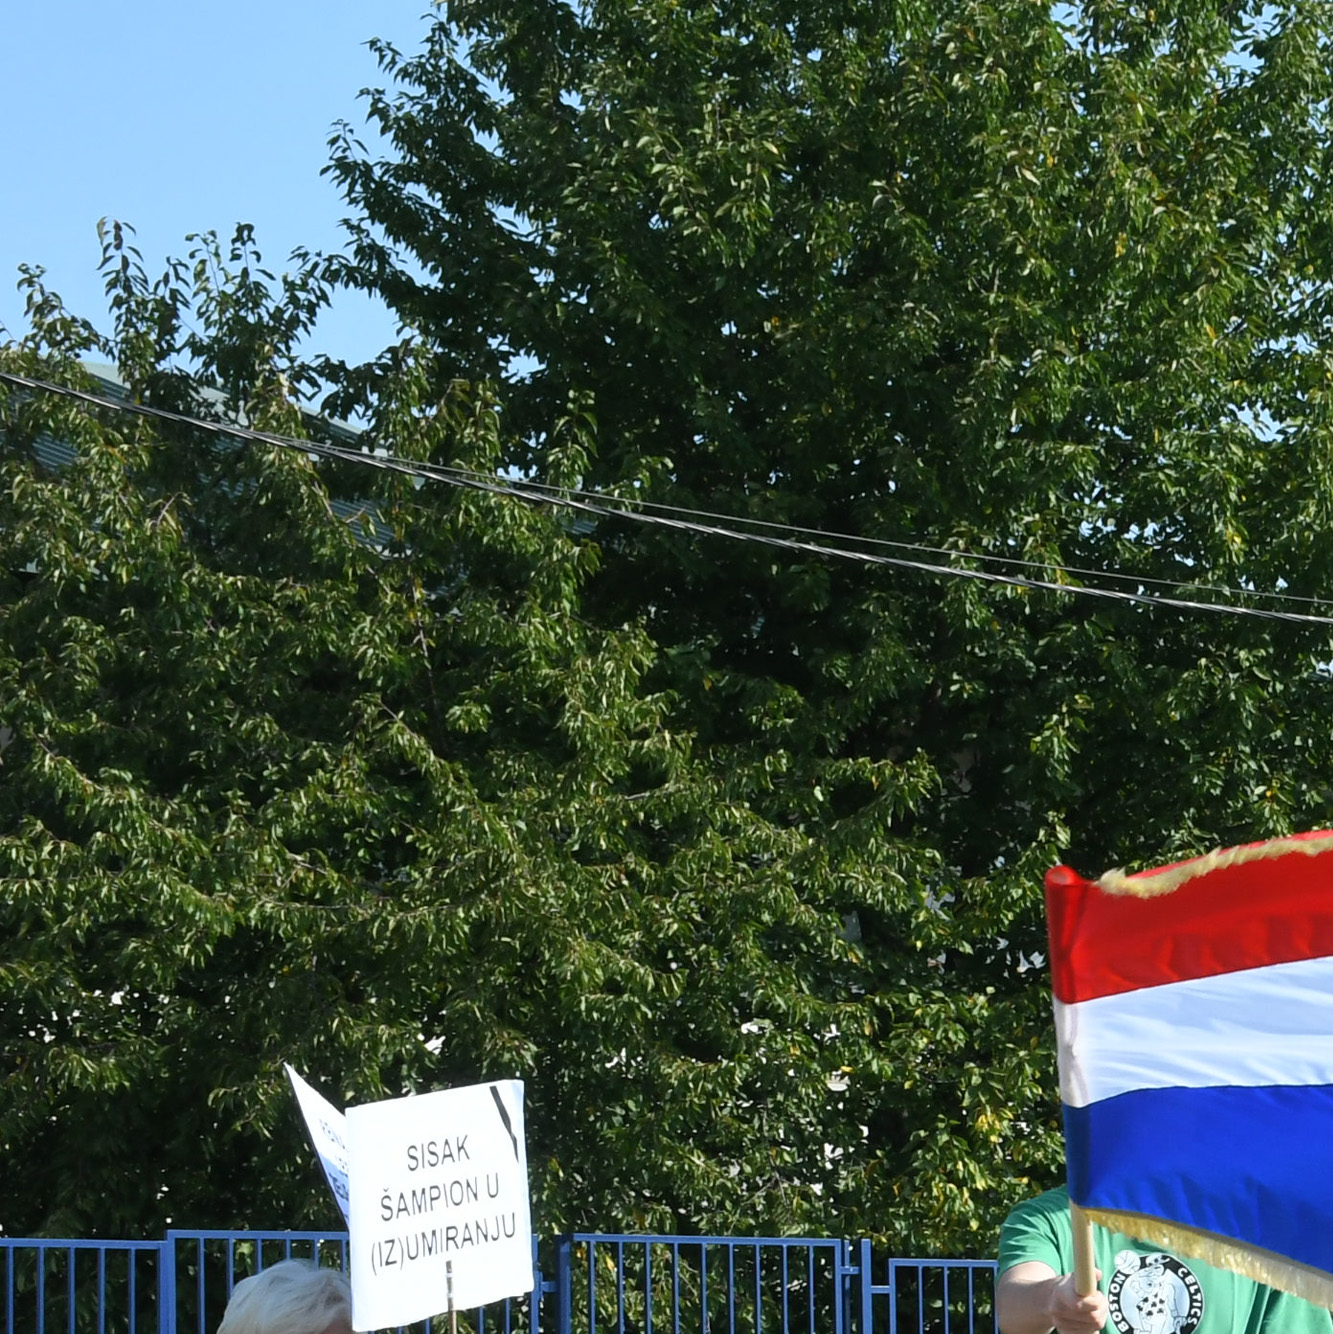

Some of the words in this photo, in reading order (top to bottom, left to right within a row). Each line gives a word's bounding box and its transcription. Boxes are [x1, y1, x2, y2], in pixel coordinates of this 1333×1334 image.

[406, 1134, 471, 1172] SISAK
[380, 1177, 479, 1222] ŠAMPION
[487, 1173, 500, 1198] U
[371, 1212, 516, 1276] (IZ)UMIRANJU
[1109, 1273, 1129, 1332] BOSTON
[1177, 1268, 1201, 1325] CELTICS
